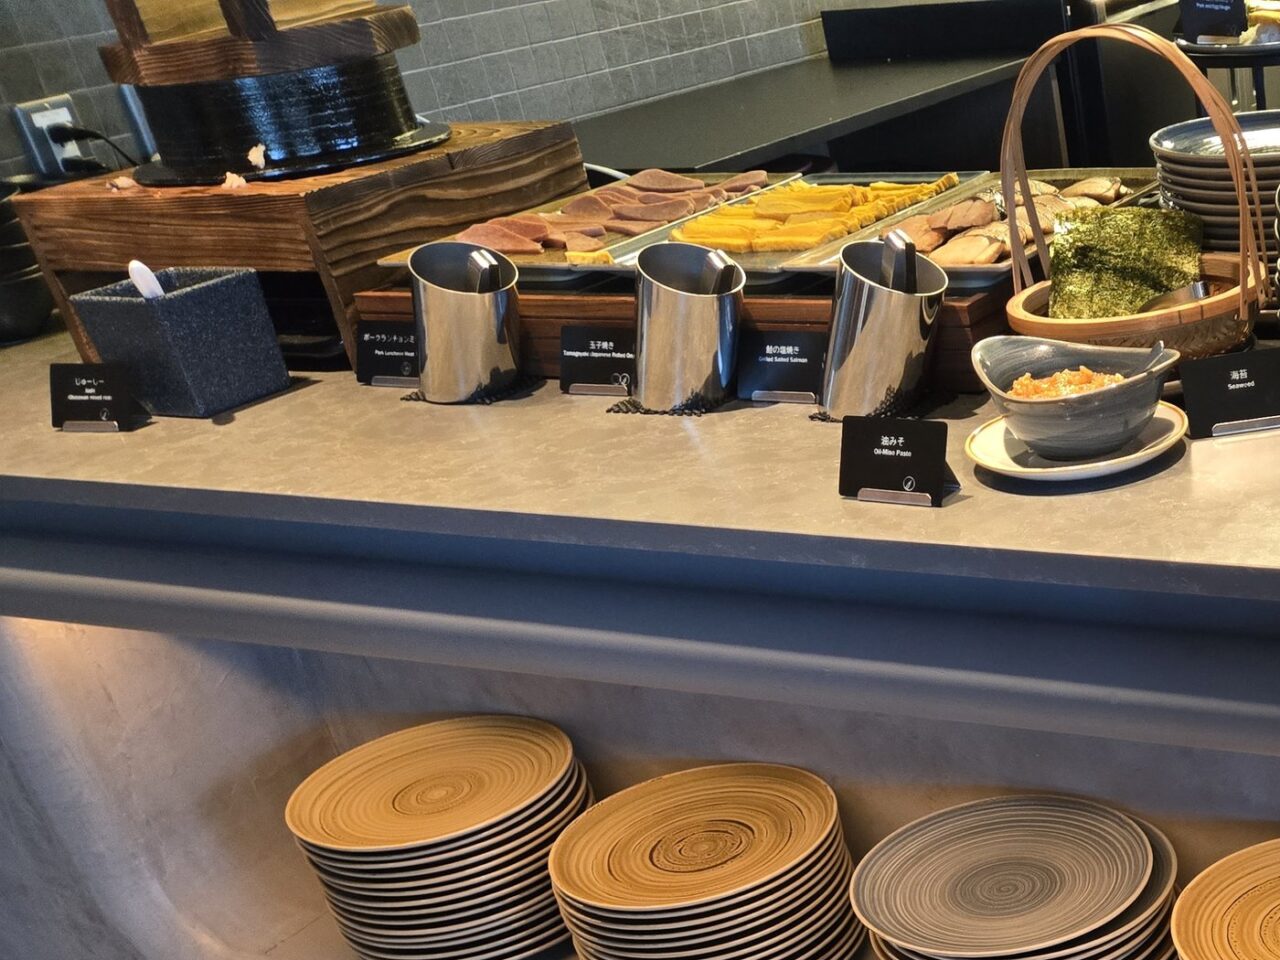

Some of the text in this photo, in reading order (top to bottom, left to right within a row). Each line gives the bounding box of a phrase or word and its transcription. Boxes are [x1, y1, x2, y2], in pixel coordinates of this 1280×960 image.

[363, 333, 415, 344] ポークランチョンミ
[590, 340, 614, 350] 玉子焼き
[1230, 368, 1247, 380] 海苔
[1227, 380, 1255, 390] Seaweed
[880, 435, 904, 446] 油みそ
[873, 448, 912, 457] Oil-Miso Paste
